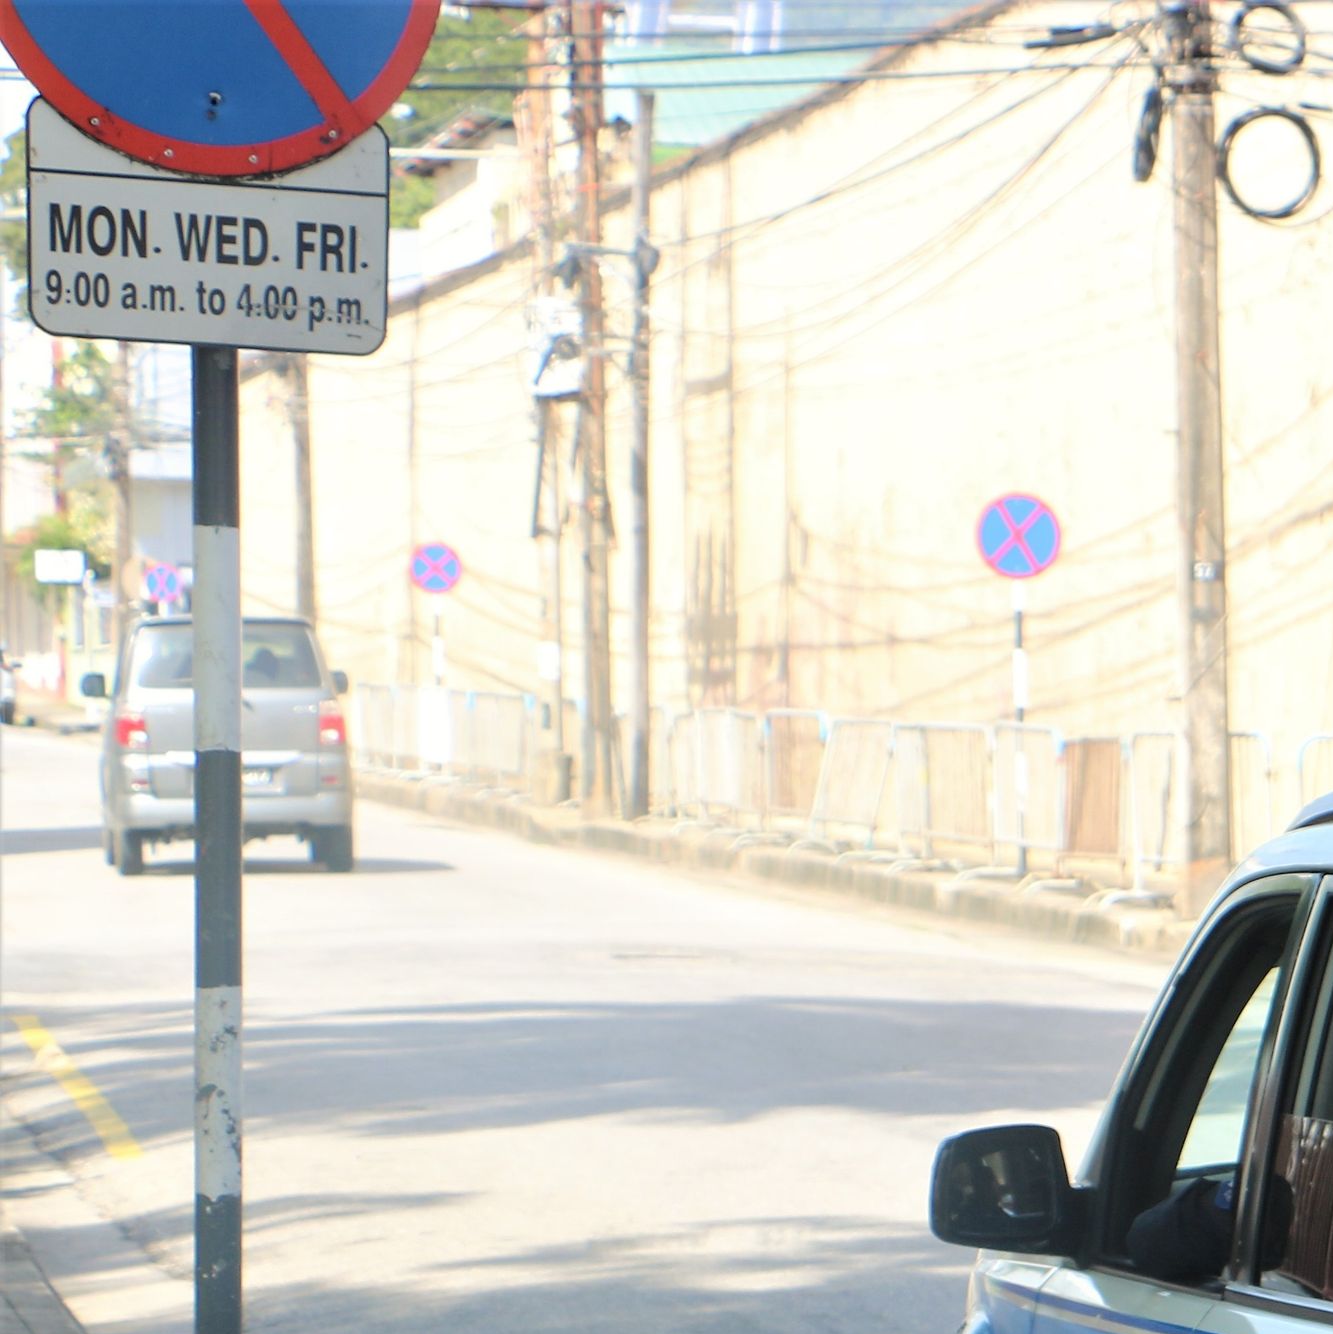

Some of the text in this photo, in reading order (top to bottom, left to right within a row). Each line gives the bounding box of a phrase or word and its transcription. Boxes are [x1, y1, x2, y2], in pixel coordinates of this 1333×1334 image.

[49, 202, 369, 274] MON. WED. FRI.
[45, 269, 371, 331] 9:00 a.m. to 4:00 p.m.
